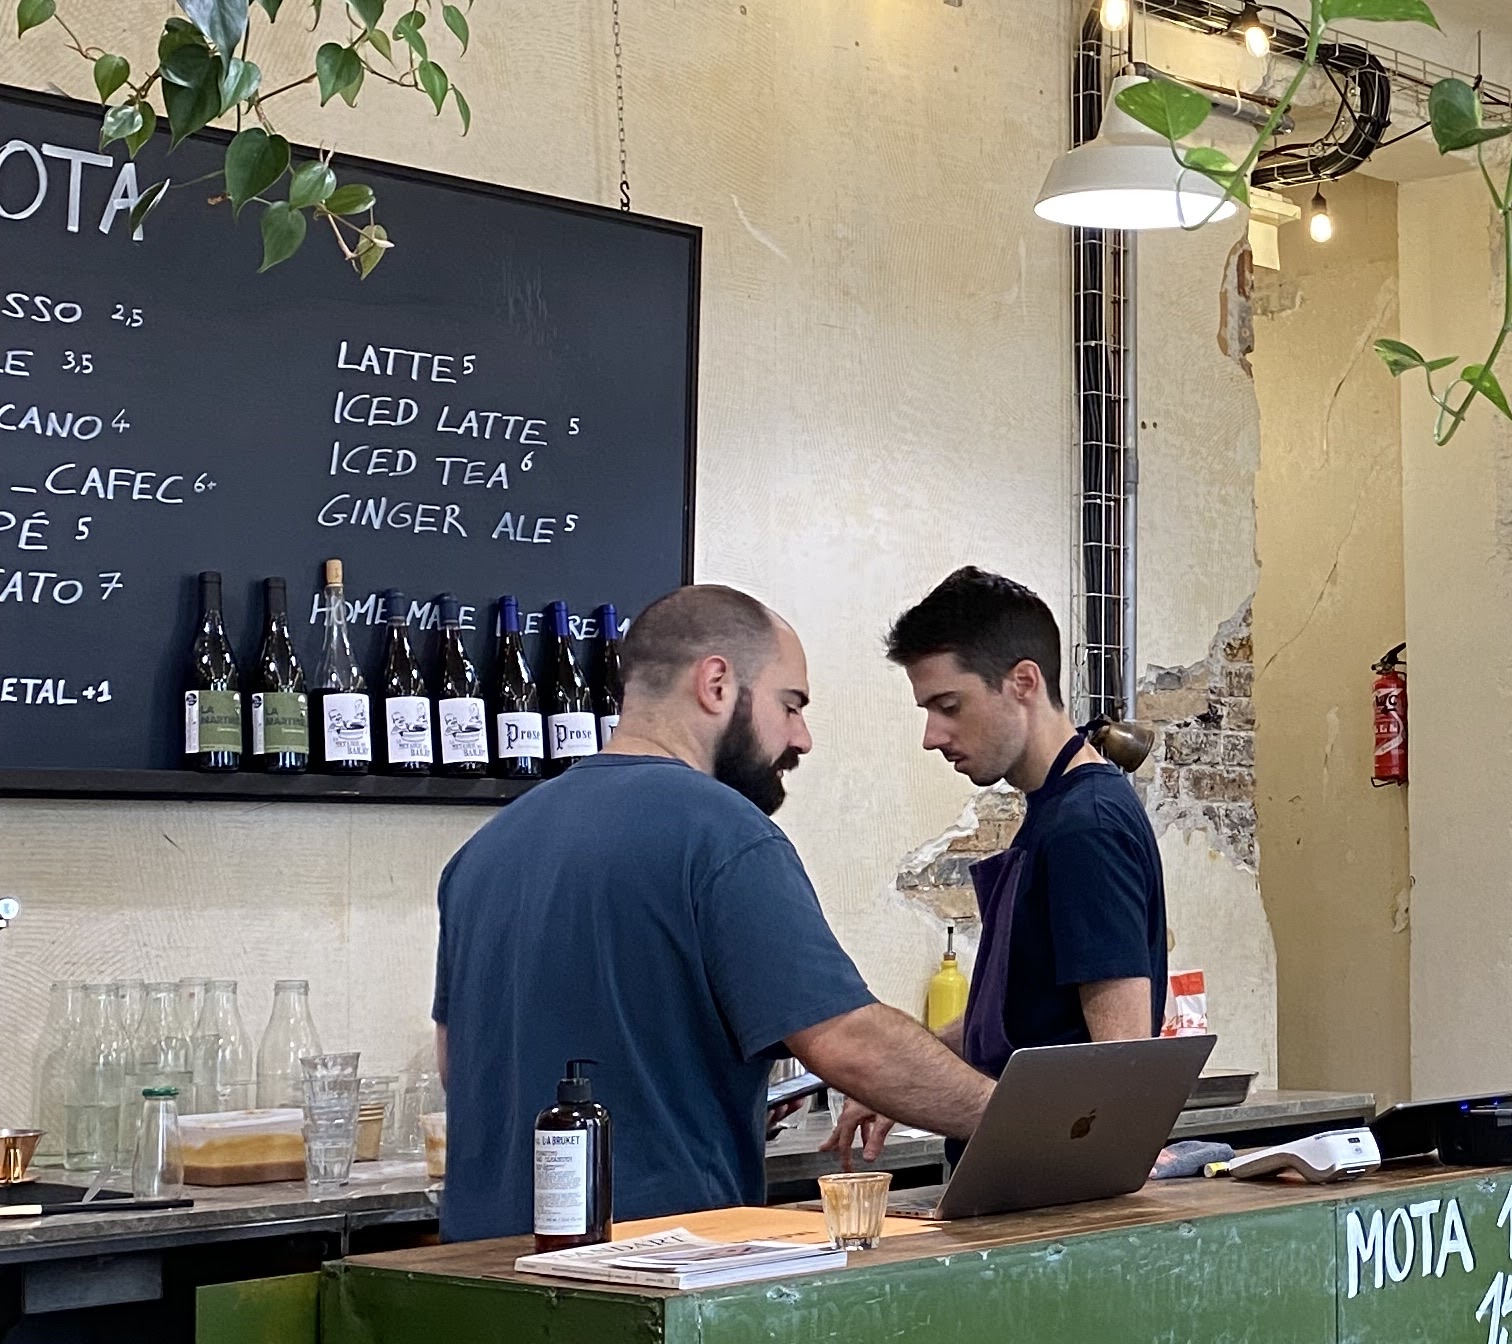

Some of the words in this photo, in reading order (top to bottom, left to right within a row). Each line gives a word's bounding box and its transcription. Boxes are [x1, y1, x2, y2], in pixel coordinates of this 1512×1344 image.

[1, 292, 83, 323] SSO
[111, 304, 144, 327] 2,5
[0, 350, 33, 376] E
[62, 350, 94, 374] 3,5
[338, 341, 456, 383] LATTE
[462, 355, 476, 374] 5
[111, 409, 130, 433] 4
[334, 391, 418, 426] ICED
[437, 406, 548, 446] LATTE
[568, 418, 580, 435] 5
[330, 441, 417, 477] ICED
[436, 457, 509, 489] TEA
[520, 451, 535, 472] 6
[75, 517, 92, 540] 5
[317, 494, 467, 538] GINGER
[492, 511, 556, 543] ALE
[564, 515, 579, 532] 5
[0, 568, 83, 604] ATO
[99, 572, 123, 600] 7
[406, 600, 476, 631] MAE
[554, 723, 592, 750] Prose
[1346, 1197, 1475, 1299] MOTA
